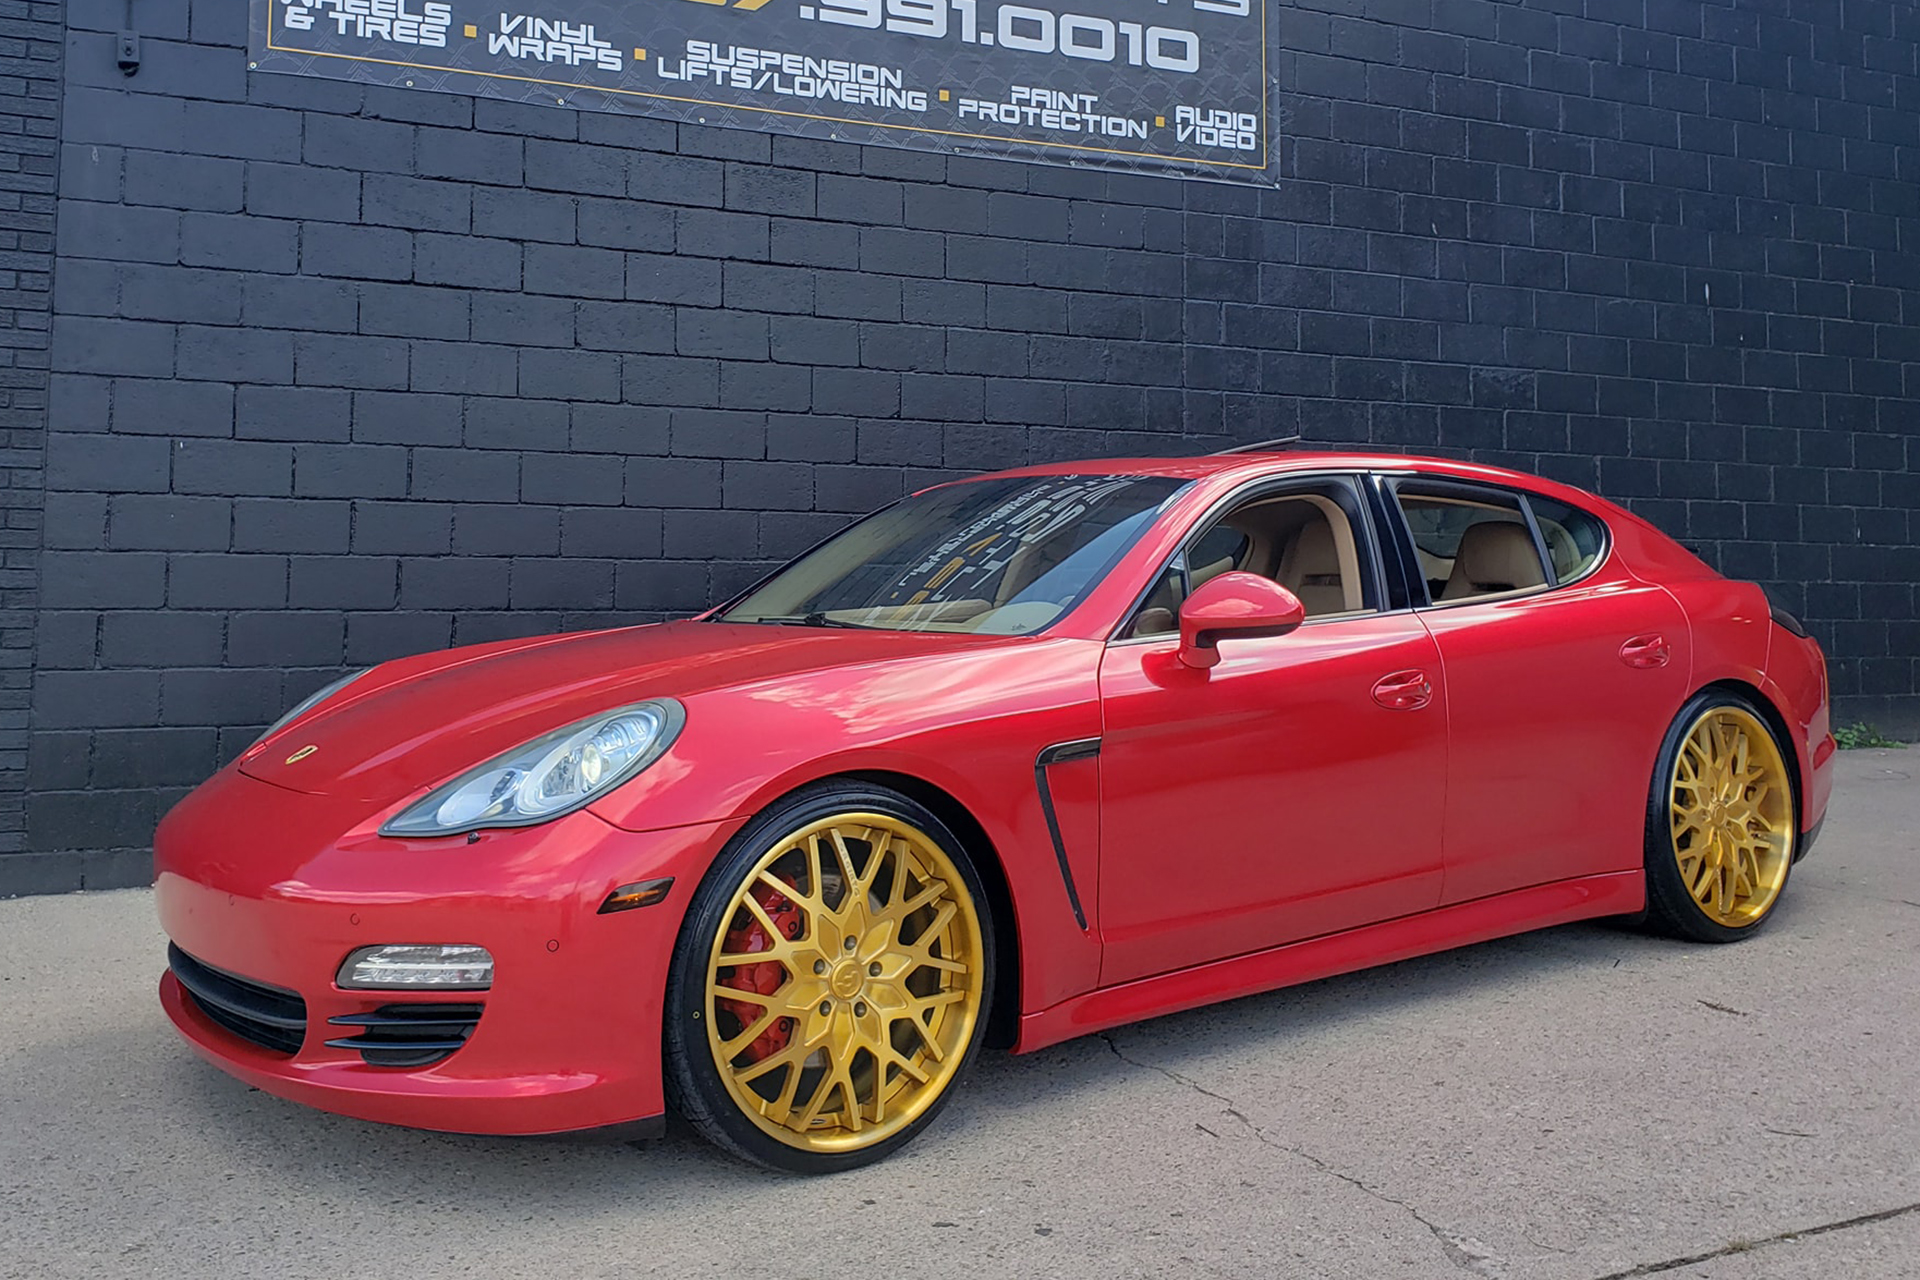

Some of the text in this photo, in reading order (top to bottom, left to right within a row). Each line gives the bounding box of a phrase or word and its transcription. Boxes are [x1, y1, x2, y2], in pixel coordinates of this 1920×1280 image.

[280, 0, 452, 26] HEELS
[285, 5, 447, 48] & TIRES
[500, 12, 612, 49] VINYL
[488, 32, 623, 72] WRAPS
[686, 39, 902, 89] SUSPENSION
[657, 56, 927, 112] LIFTS/LOWERING
[1011, 85, 1099, 114] PAINT
[958, 98, 1148, 140] PROTECTION
[1175, 105, 1257, 133] AUDIO
[1176, 123, 1256, 151] VIDEO
